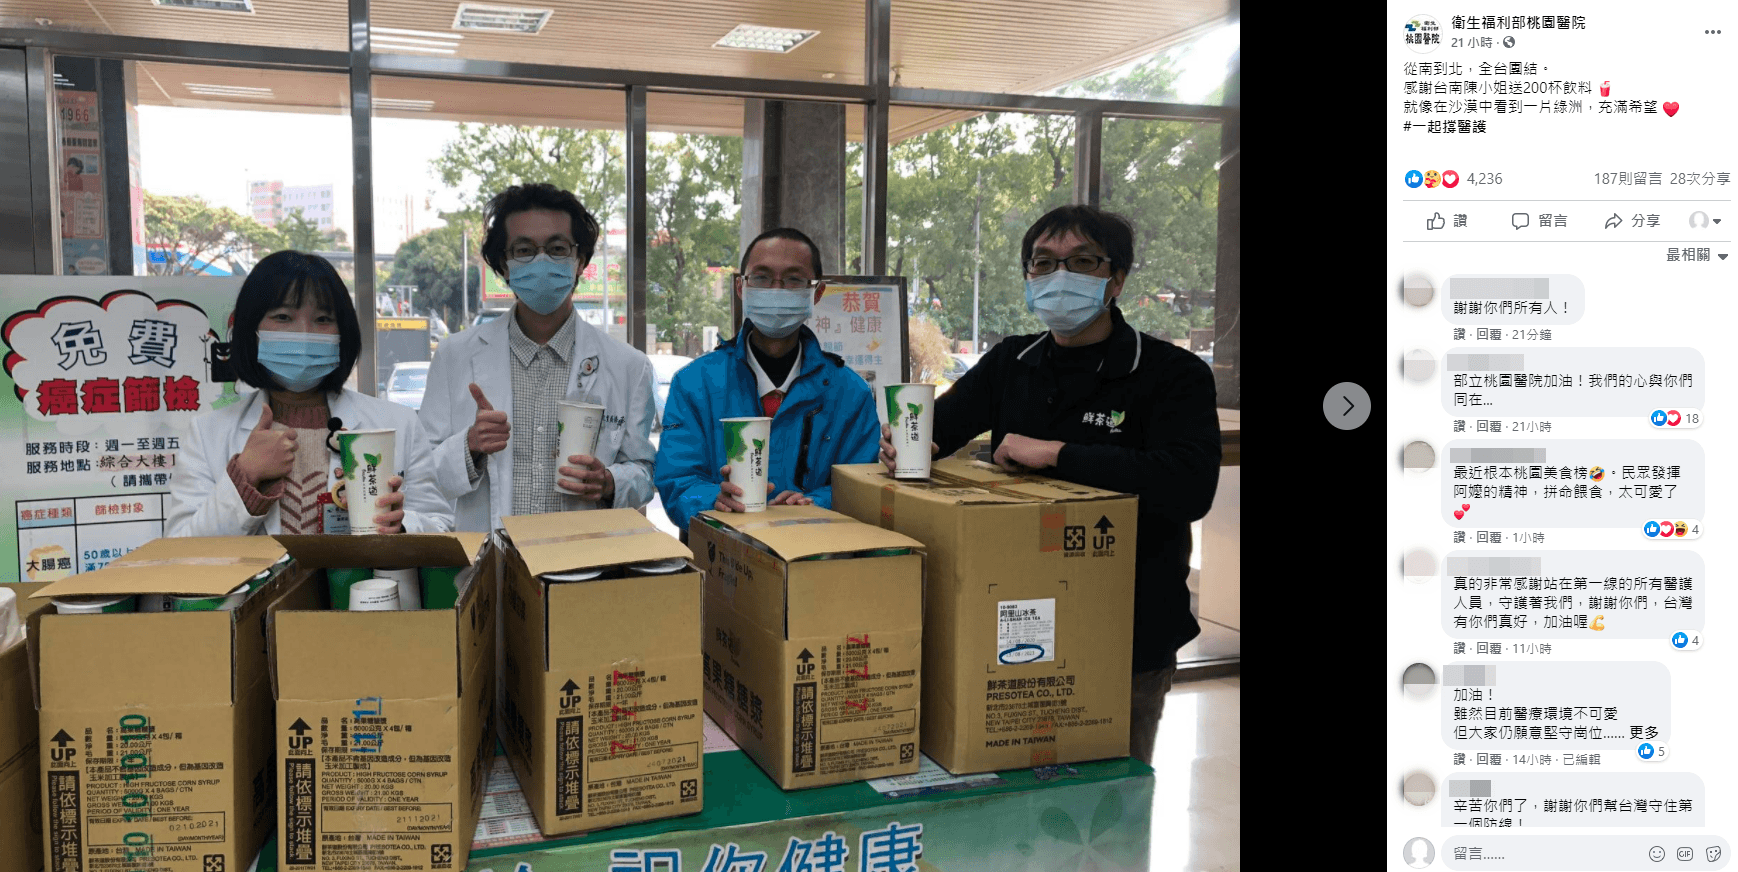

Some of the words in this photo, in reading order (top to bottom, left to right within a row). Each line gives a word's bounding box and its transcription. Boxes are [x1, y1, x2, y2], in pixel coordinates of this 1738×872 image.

[1452, 15, 1586, 29] 衛生福利部桃園醫院
[1406, 32, 1440, 45] 桃園醫院
[1451, 38, 1463, 47] 21
[1468, 37, 1493, 48] 小時
[1404, 62, 1548, 75] 從南到北，全台團結。
[1404, 80, 1592, 94] 感謝台南陳小姐送200杯飲料
[1404, 99, 1657, 113] 就像在沙漠中看到一片綠洲，充滿希望
[61, 107, 89, 121] 1966
[1403, 120, 1486, 133] #一起撐醫護
[1467, 173, 1502, 186] 4,236
[1595, 172, 1662, 185] 187則留言
[1670, 172, 1731, 185] 28次分享
[1453, 214, 1467, 227] 讚
[1539, 214, 1568, 227] 留言
[1631, 214, 1660, 227] 分享
[1666, 248, 1710, 261] 最相關
[843, 292, 881, 313] 恭賀
[1454, 301, 1567, 314] 謝謝你們所有人！
[815, 315, 882, 334] 神』健康
[1453, 328, 1466, 340] 讚
[1477, 328, 1502, 340] 回覆
[1512, 329, 1552, 340] 21分鐘
[51, 319, 178, 370] 免費
[1454, 374, 1692, 387] 部立桃園醫院加油！我們的心與你們
[37, 375, 201, 416] 癌症篩檢
[1454, 393, 1492, 406] 同在...
[1686, 414, 1699, 423] 18
[1453, 420, 1466, 432] 讚
[1477, 420, 1502, 432] 回覆
[1512, 421, 1552, 432] 21小時
[26, 437, 180, 456] 服務時段：週一至週五
[1454, 466, 1587, 479] 最近根本桃園美食榜
[111, 472, 172, 488] （請攜帶
[1454, 484, 1677, 498] 阿嬤的精神，拼命餵食，太可愛了
[20, 507, 73, 521] 癌症種類
[95, 503, 145, 516] 篩檢對象
[1692, 525, 1699, 534] 4
[1093, 535, 1116, 550] UP
[1453, 531, 1466, 543] 讚
[1477, 531, 1502, 543] 回覆
[1513, 532, 1545, 543] 1小時
[26, 558, 72, 572] 大腸癌
[1454, 577, 1692, 590] 真的非常感謝站在第一線的所有醫護
[1454, 596, 1692, 609] 人員，守護著我們，謝謝你們，台灣
[1000, 608, 1036, 617] 阿里山冰茶
[1454, 615, 1588, 628] 有你們真好，加油喔
[1692, 636, 1699, 645] 4
[1453, 642, 1466, 654] 讚
[1477, 642, 1502, 654] 回覆
[1513, 643, 1552, 654] 11小時
[796, 663, 815, 675] UP
[987, 675, 1075, 691] 鮮茶道股份有限公司
[986, 690, 1034, 701] PRESOTEA
[1056, 687, 1075, 696] LTD.
[1454, 688, 1492, 701] 加油！
[559, 695, 581, 709] UP
[1454, 707, 1618, 720] 雖然目前醫療環境不可愛
[801, 687, 814, 768] 請依標示堆疊
[1630, 726, 1658, 739] 更多
[288, 736, 313, 749] UP
[986, 739, 1009, 748] MADE
[1012, 738, 1021, 746] IN
[1023, 735, 1056, 745] TAIWAN
[50, 748, 77, 761] UP
[1659, 747, 1665, 756] 5
[1453, 753, 1466, 765] 讚
[1477, 753, 1502, 765] 回覆
[1513, 754, 1552, 765] 14小時
[1563, 754, 1601, 765] 已編輯
[565, 720, 580, 812] 請依標示堆疊
[296, 763, 312, 860] 請依標示堆疊
[1454, 798, 1693, 812] 辛苦你們了，謝謝你們幫台灣守住第
[59, 775, 79, 872] 請依標示堆疊
